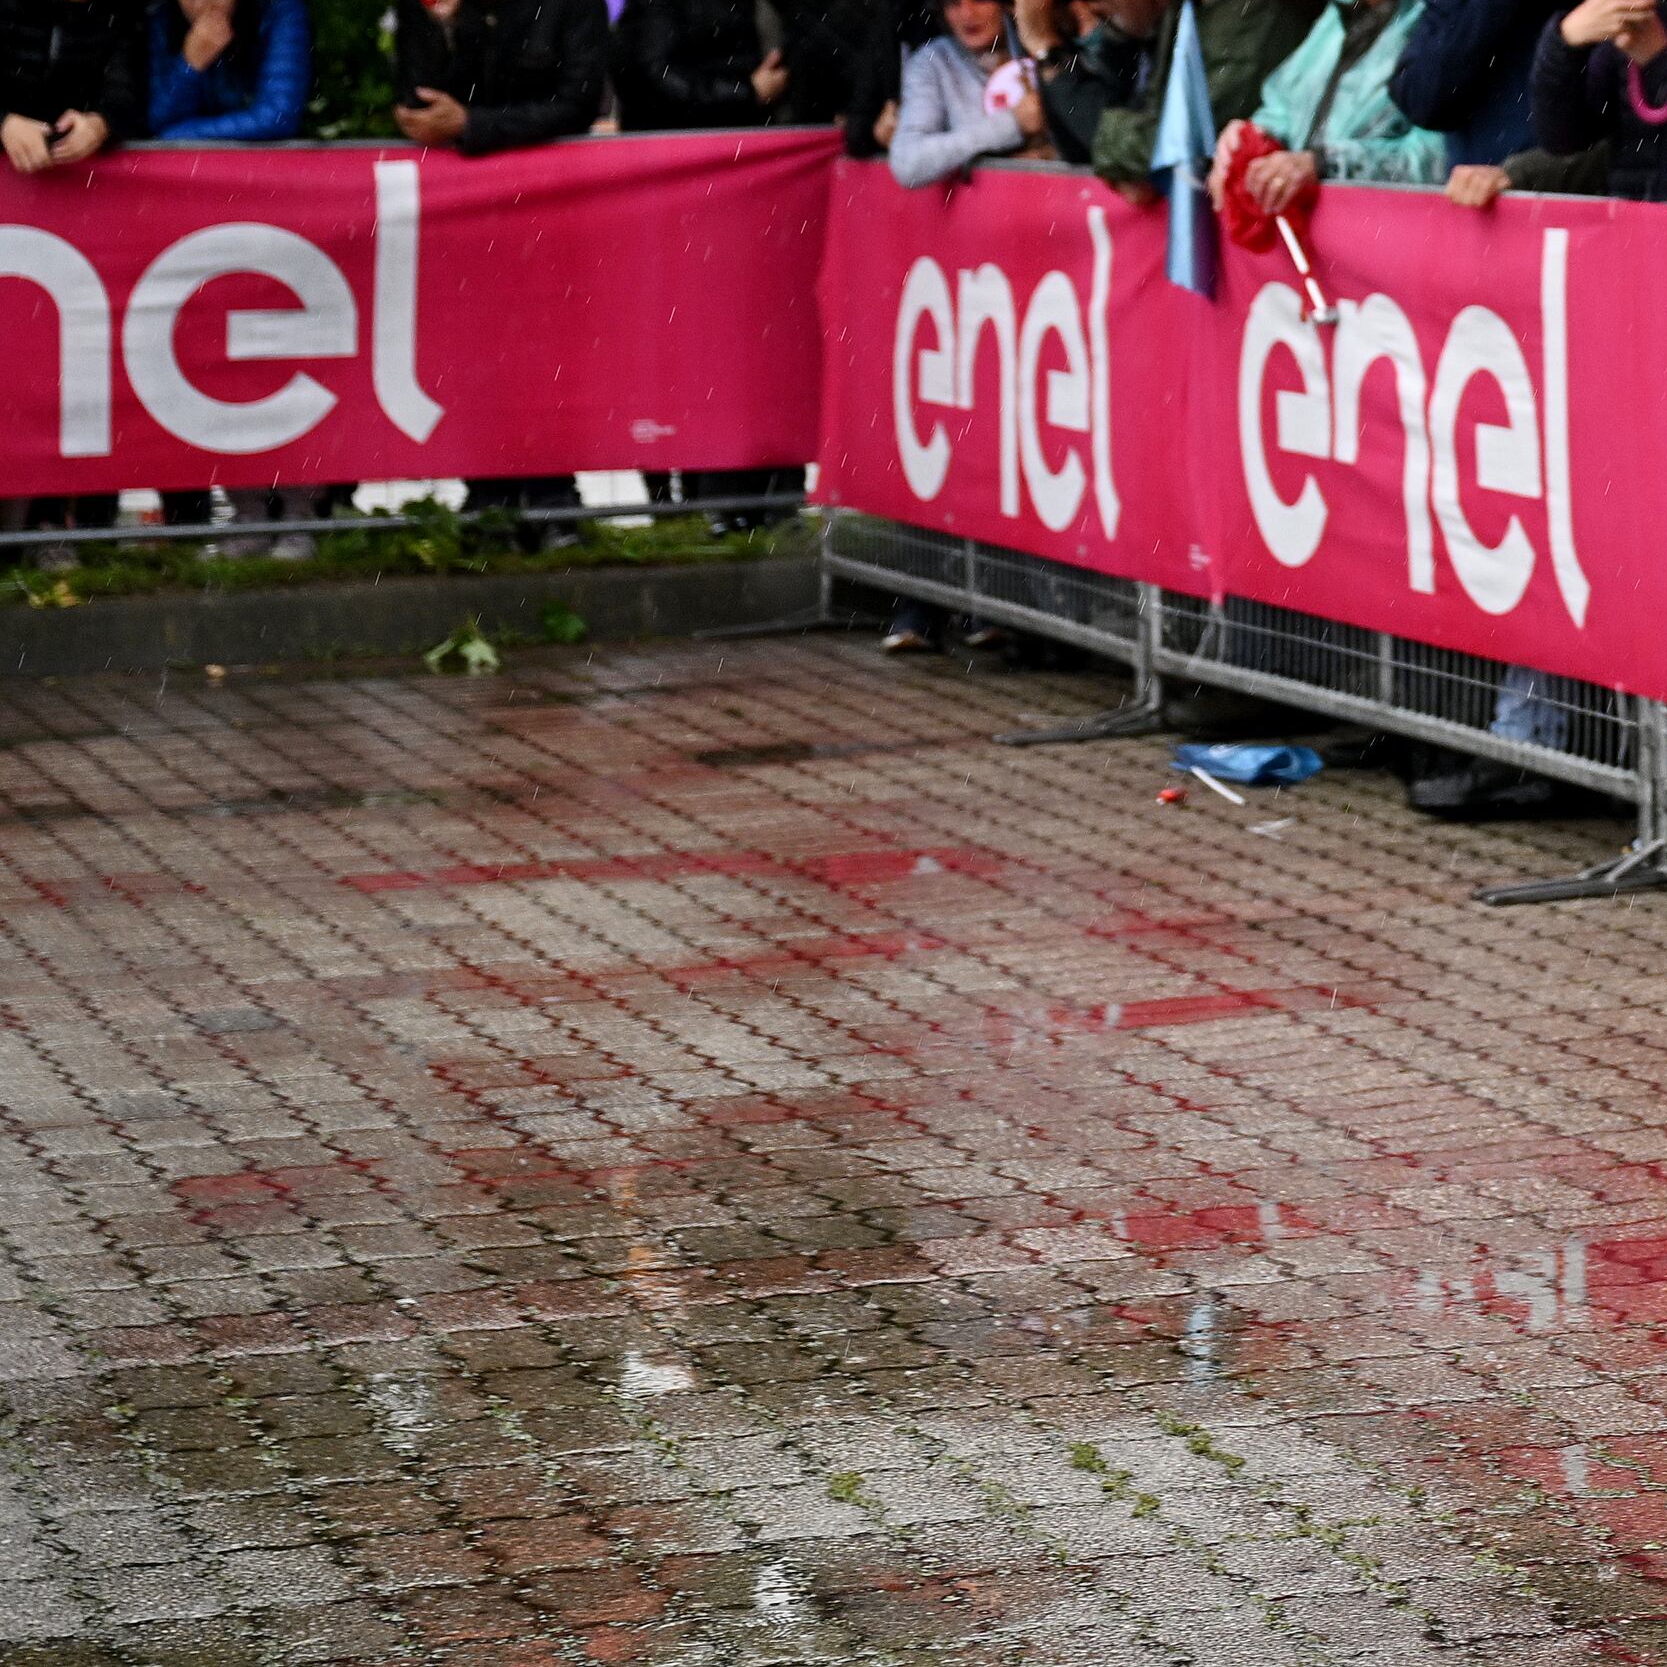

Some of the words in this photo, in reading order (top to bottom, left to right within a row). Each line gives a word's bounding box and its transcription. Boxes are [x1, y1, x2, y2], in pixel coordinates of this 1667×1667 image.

[0, 160, 445, 459] nel
[892, 206, 1121, 540] enel
[1238, 228, 1591, 630] enel
